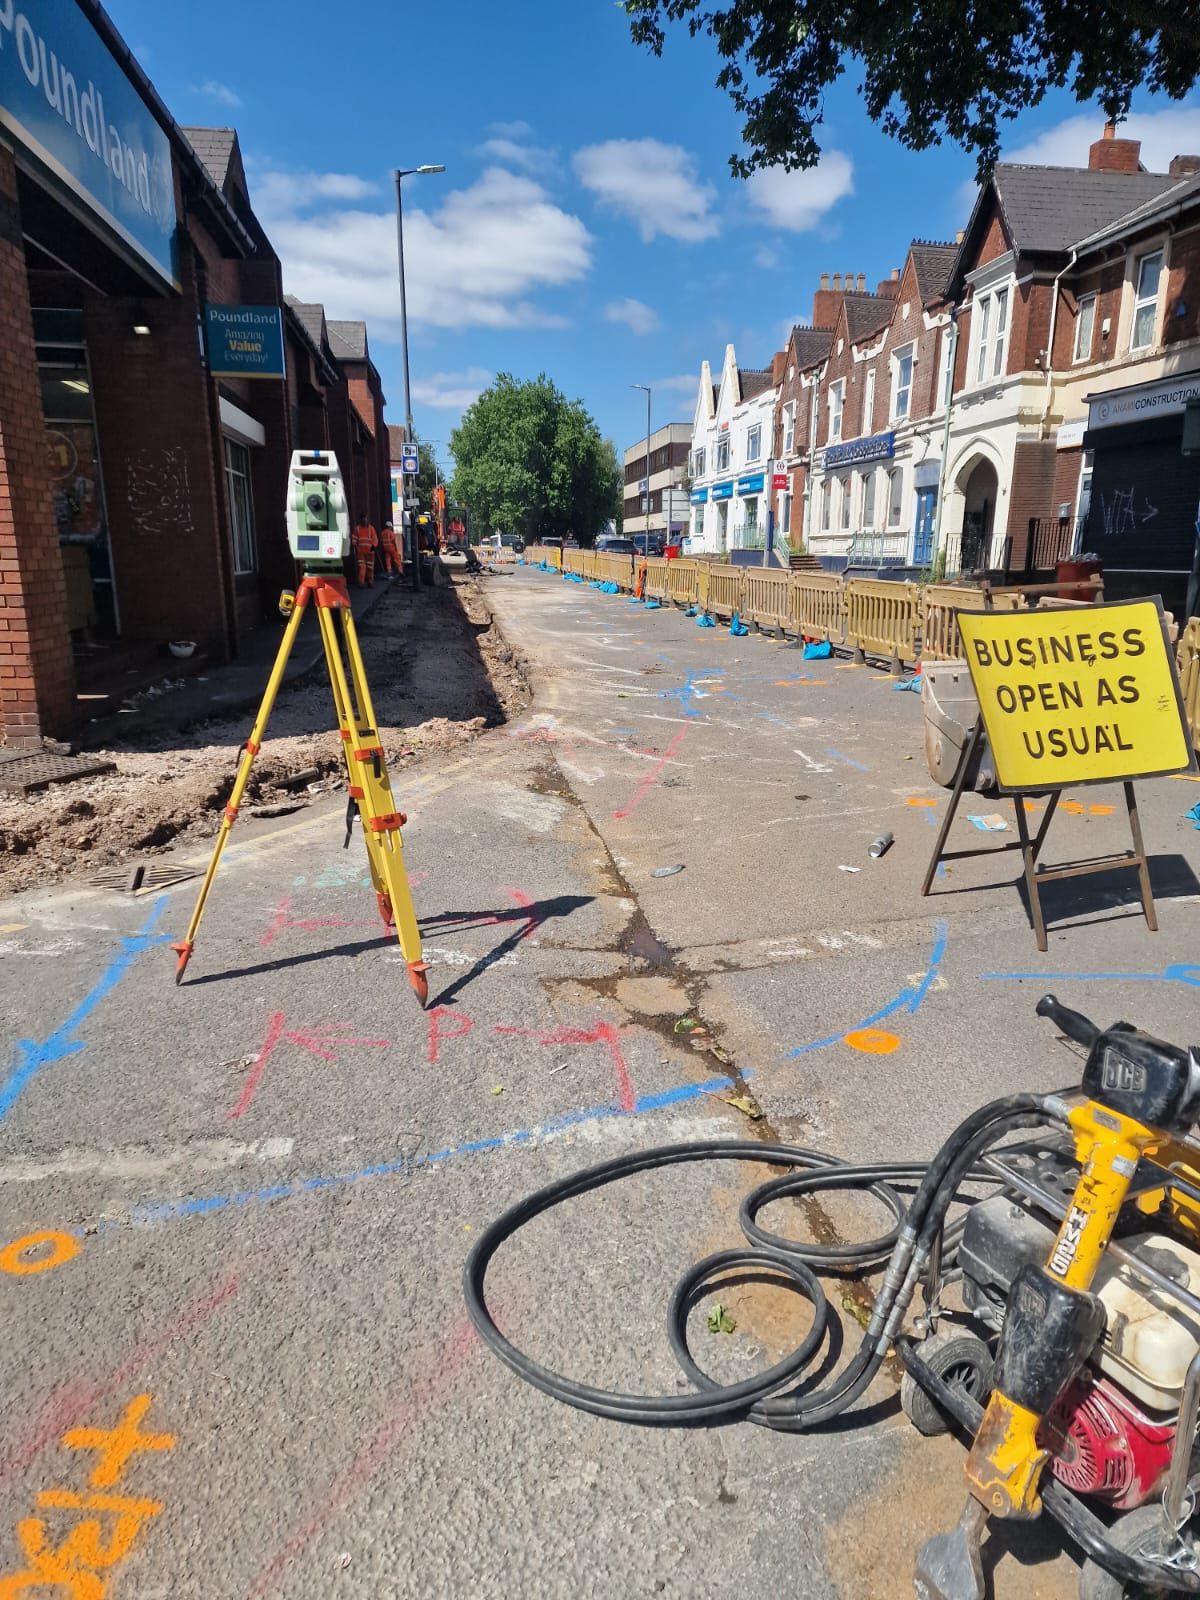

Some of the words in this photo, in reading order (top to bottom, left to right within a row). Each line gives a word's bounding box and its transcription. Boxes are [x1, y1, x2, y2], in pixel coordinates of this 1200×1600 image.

[209, 309, 277, 324] Poundland
[225, 328, 265, 342] Amazing
[229, 339, 262, 352] Value
[973, 628, 1146, 667] BUSINESS
[996, 681, 1084, 714] OPEN
[1097, 675, 1140, 707] AS
[1023, 723, 1134, 760] USUAL
[1106, 1053, 1145, 1092] JCB
